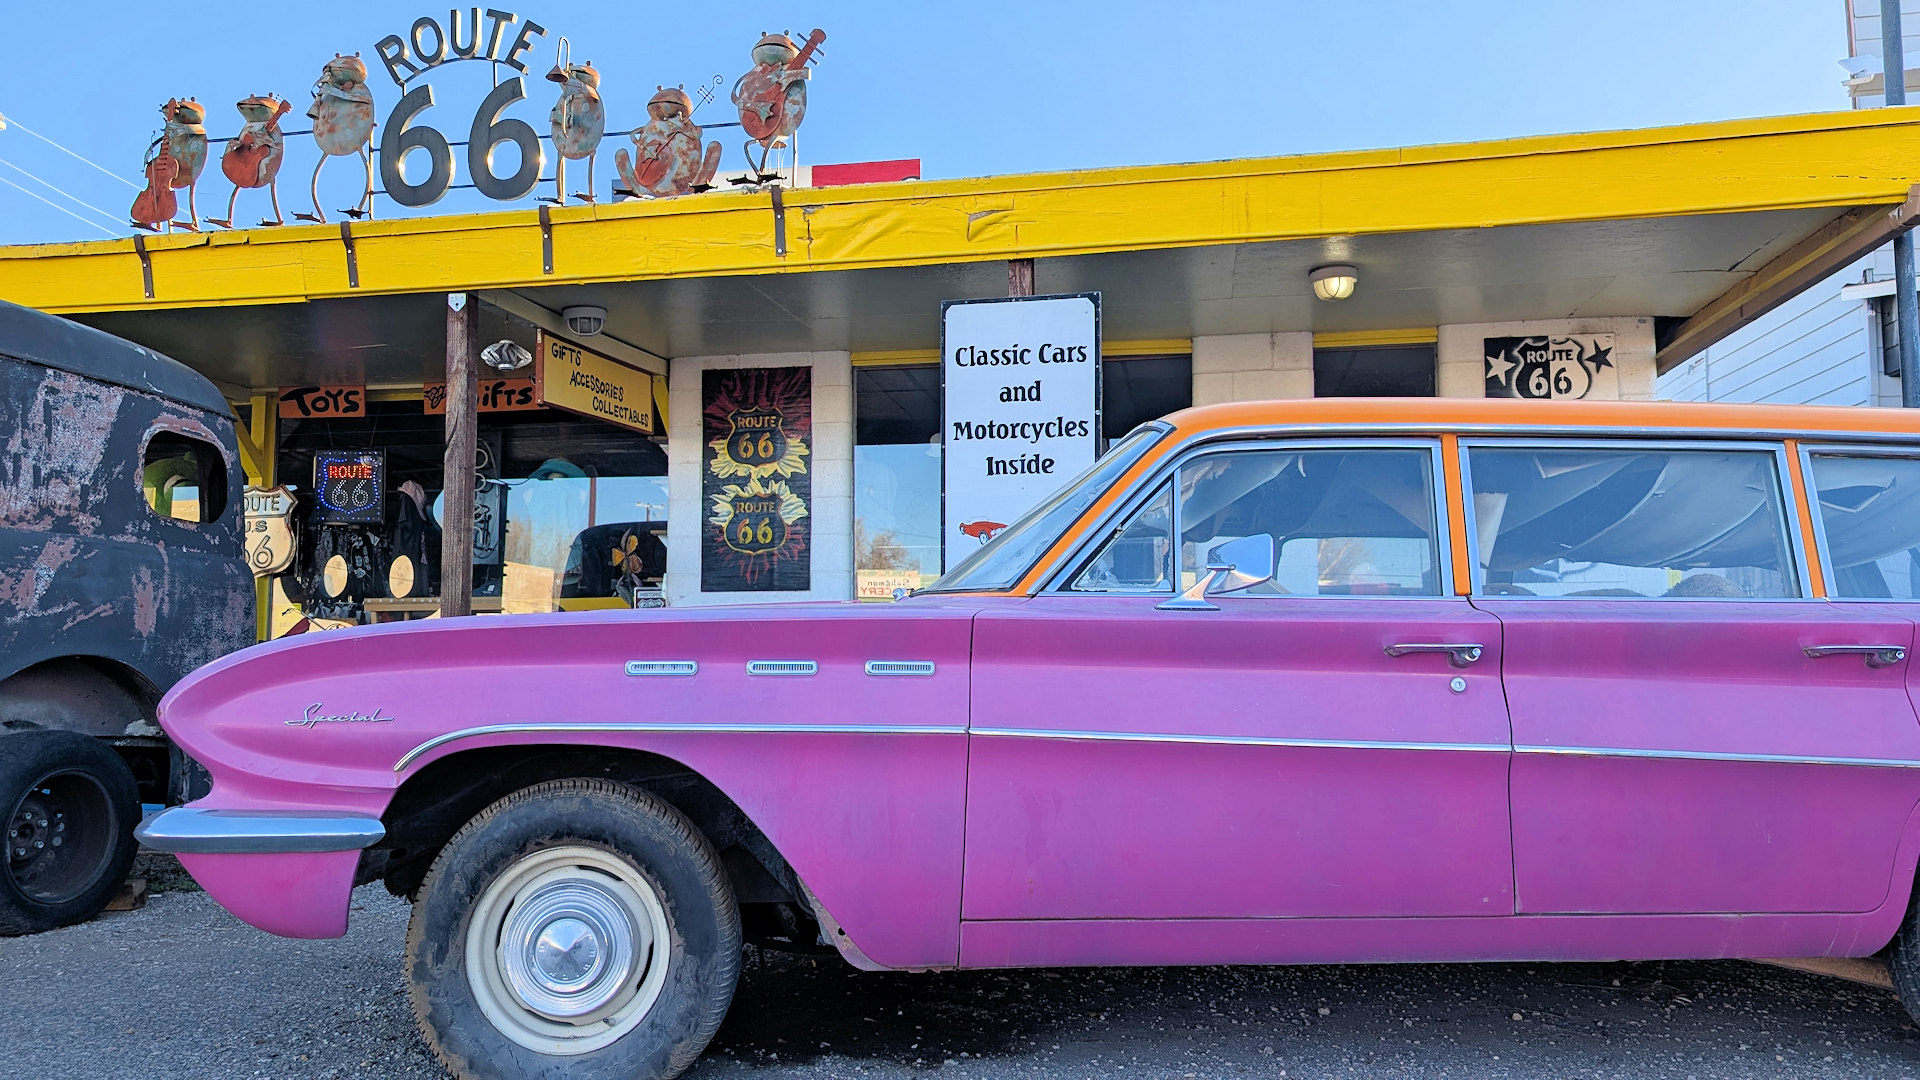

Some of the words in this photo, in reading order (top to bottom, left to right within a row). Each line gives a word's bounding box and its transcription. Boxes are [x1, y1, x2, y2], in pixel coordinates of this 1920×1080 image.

[375, 8, 548, 85] ROUTE
[380, 77, 546, 208] 66
[955, 343, 1031, 367] Classic
[1038, 343, 1087, 364] Cars
[1526, 349, 1574, 364] ROUTE
[999, 380, 1042, 402] and
[1528, 367, 1572, 397] 66
[592, 396, 649, 428] COLLECTABLES
[737, 416, 777, 429] ROUTE
[953, 416, 1089, 444] Motorcycles
[738, 432, 774, 459] 66
[328, 465, 373, 478] ROUTE
[986, 454, 1054, 476] Inside
[244, 495, 281, 512] OUTE
[331, 479, 369, 507] 66
[736, 501, 775, 514] ROUTE
[737, 517, 773, 544] 66
[284, 702, 395, 729] Special
